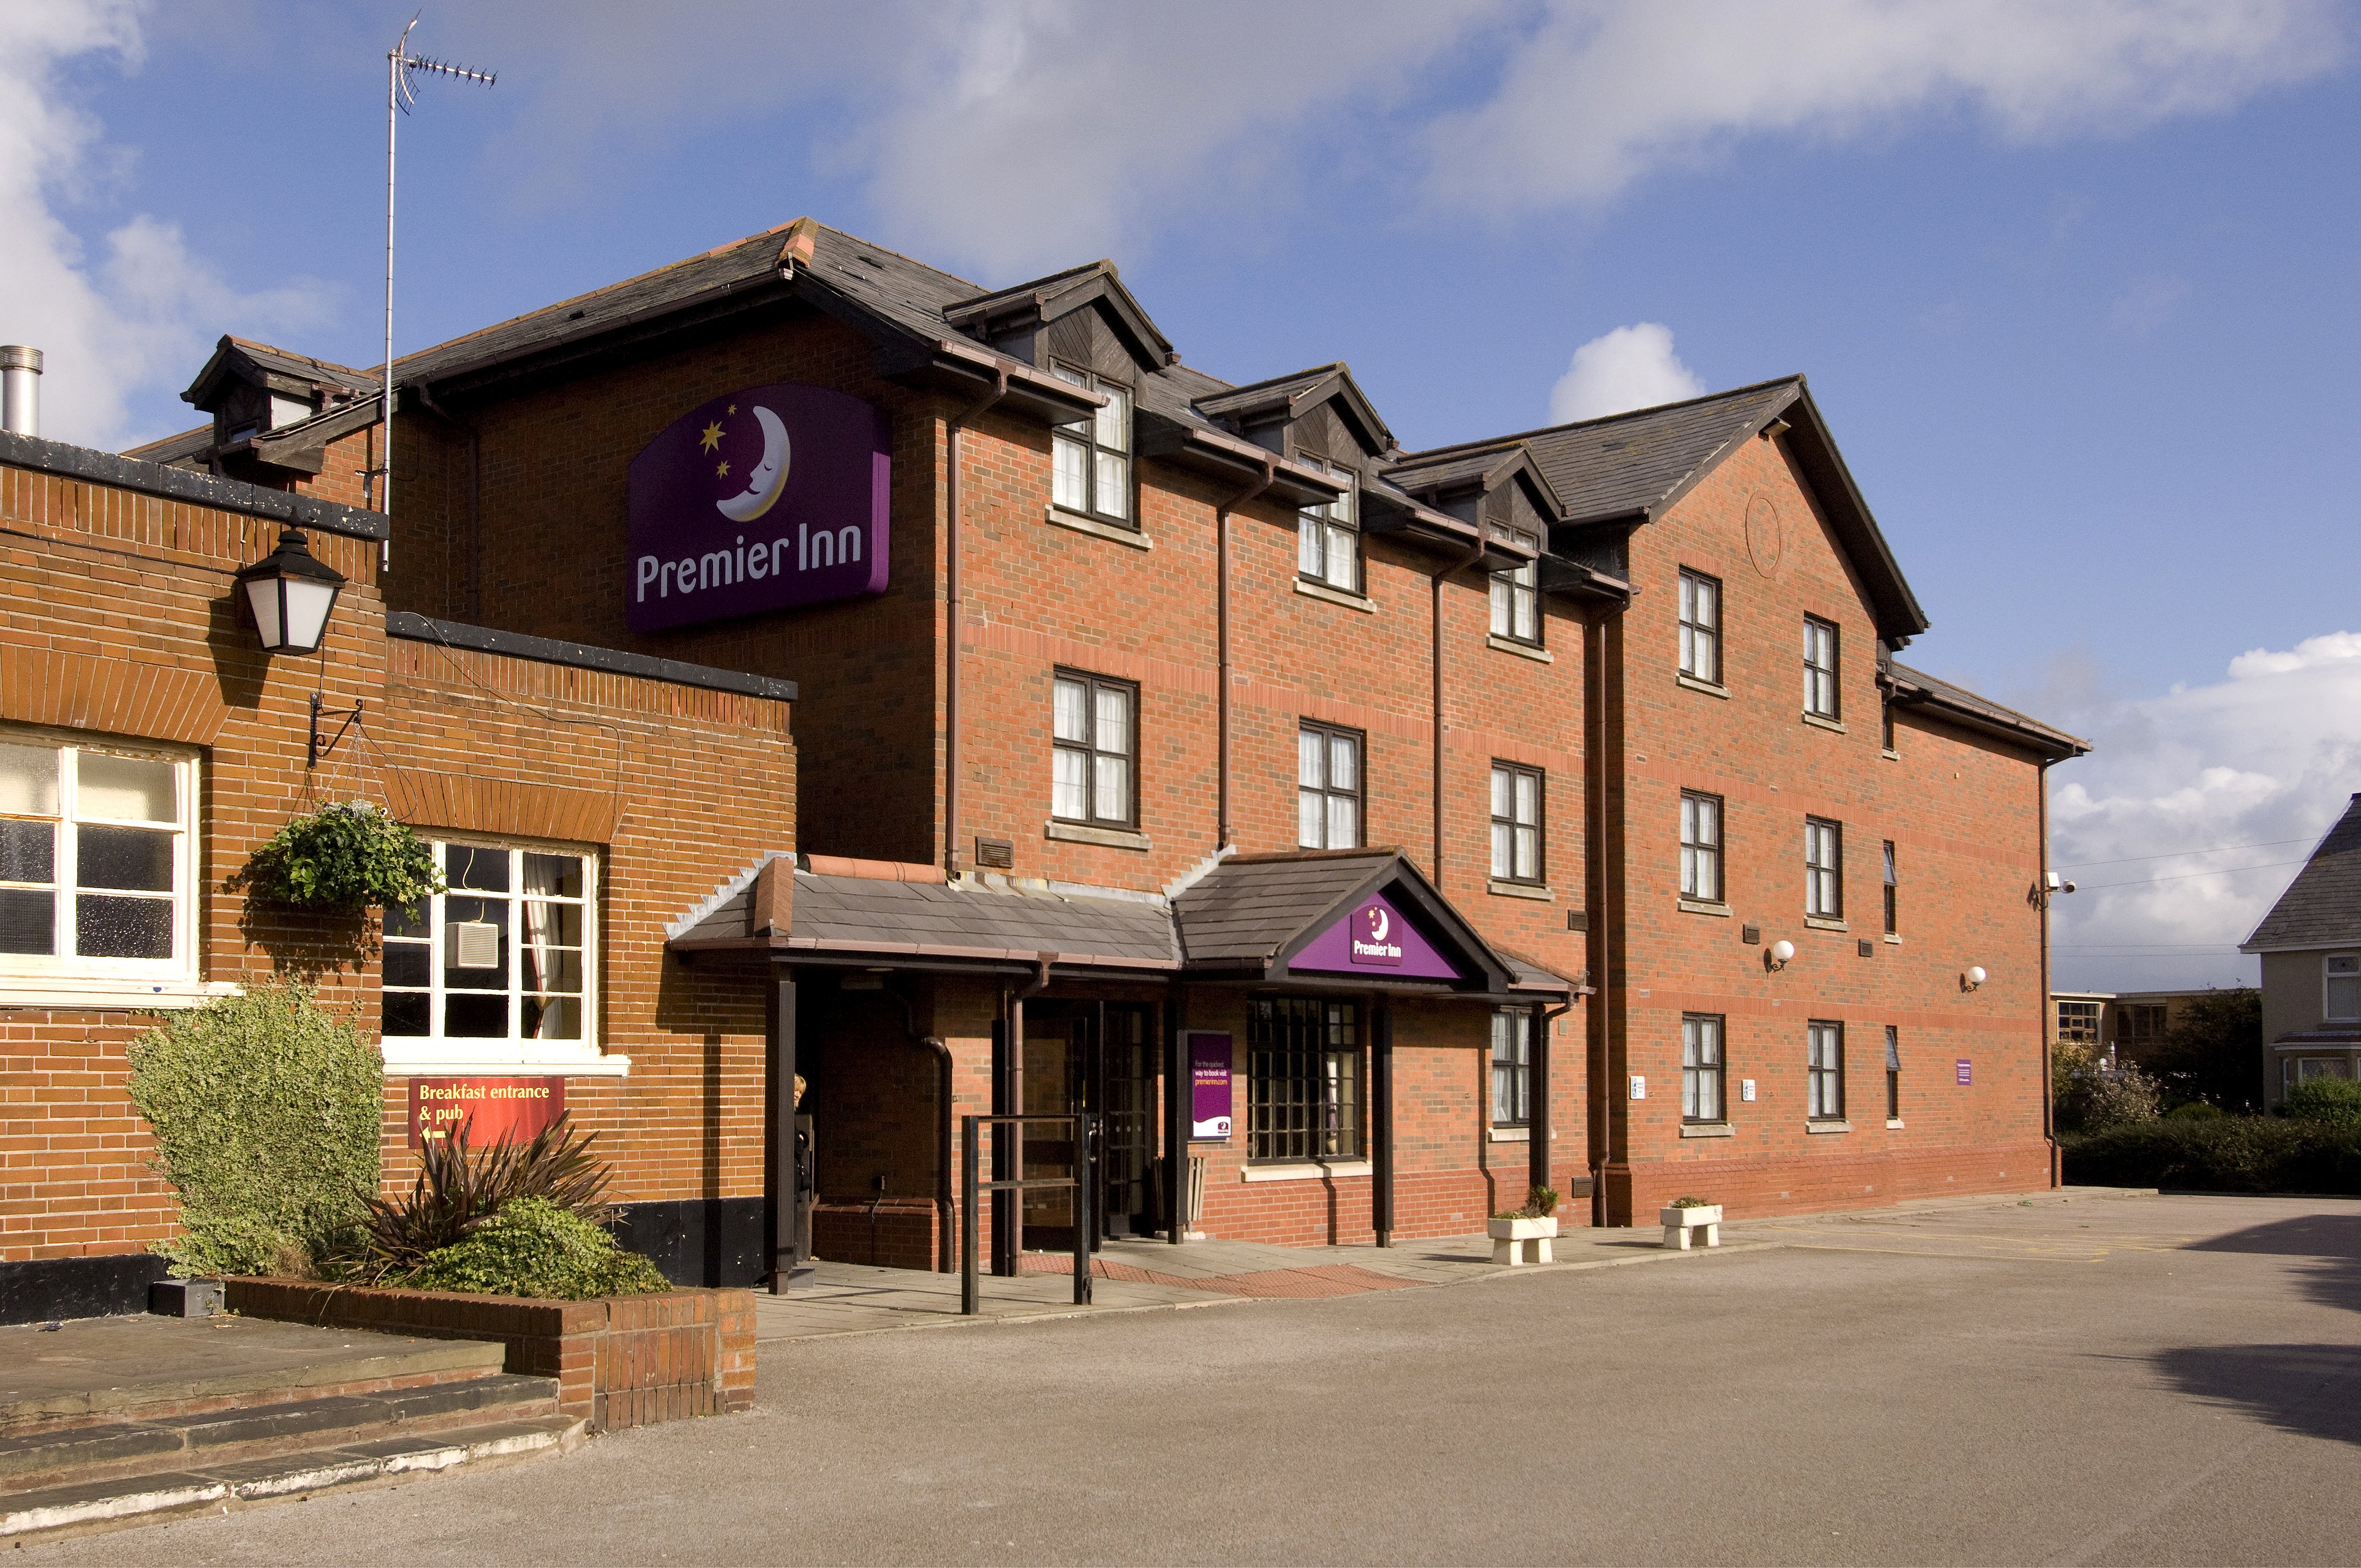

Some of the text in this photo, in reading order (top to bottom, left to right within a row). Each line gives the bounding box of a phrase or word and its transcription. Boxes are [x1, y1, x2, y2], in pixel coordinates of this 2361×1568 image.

[637, 522, 861, 602] Premier Inn
[1354, 940, 1401, 957] Premier Inn
[420, 1084, 550, 1099] Breakfast entrance
[419, 1103, 464, 1125] & pub
